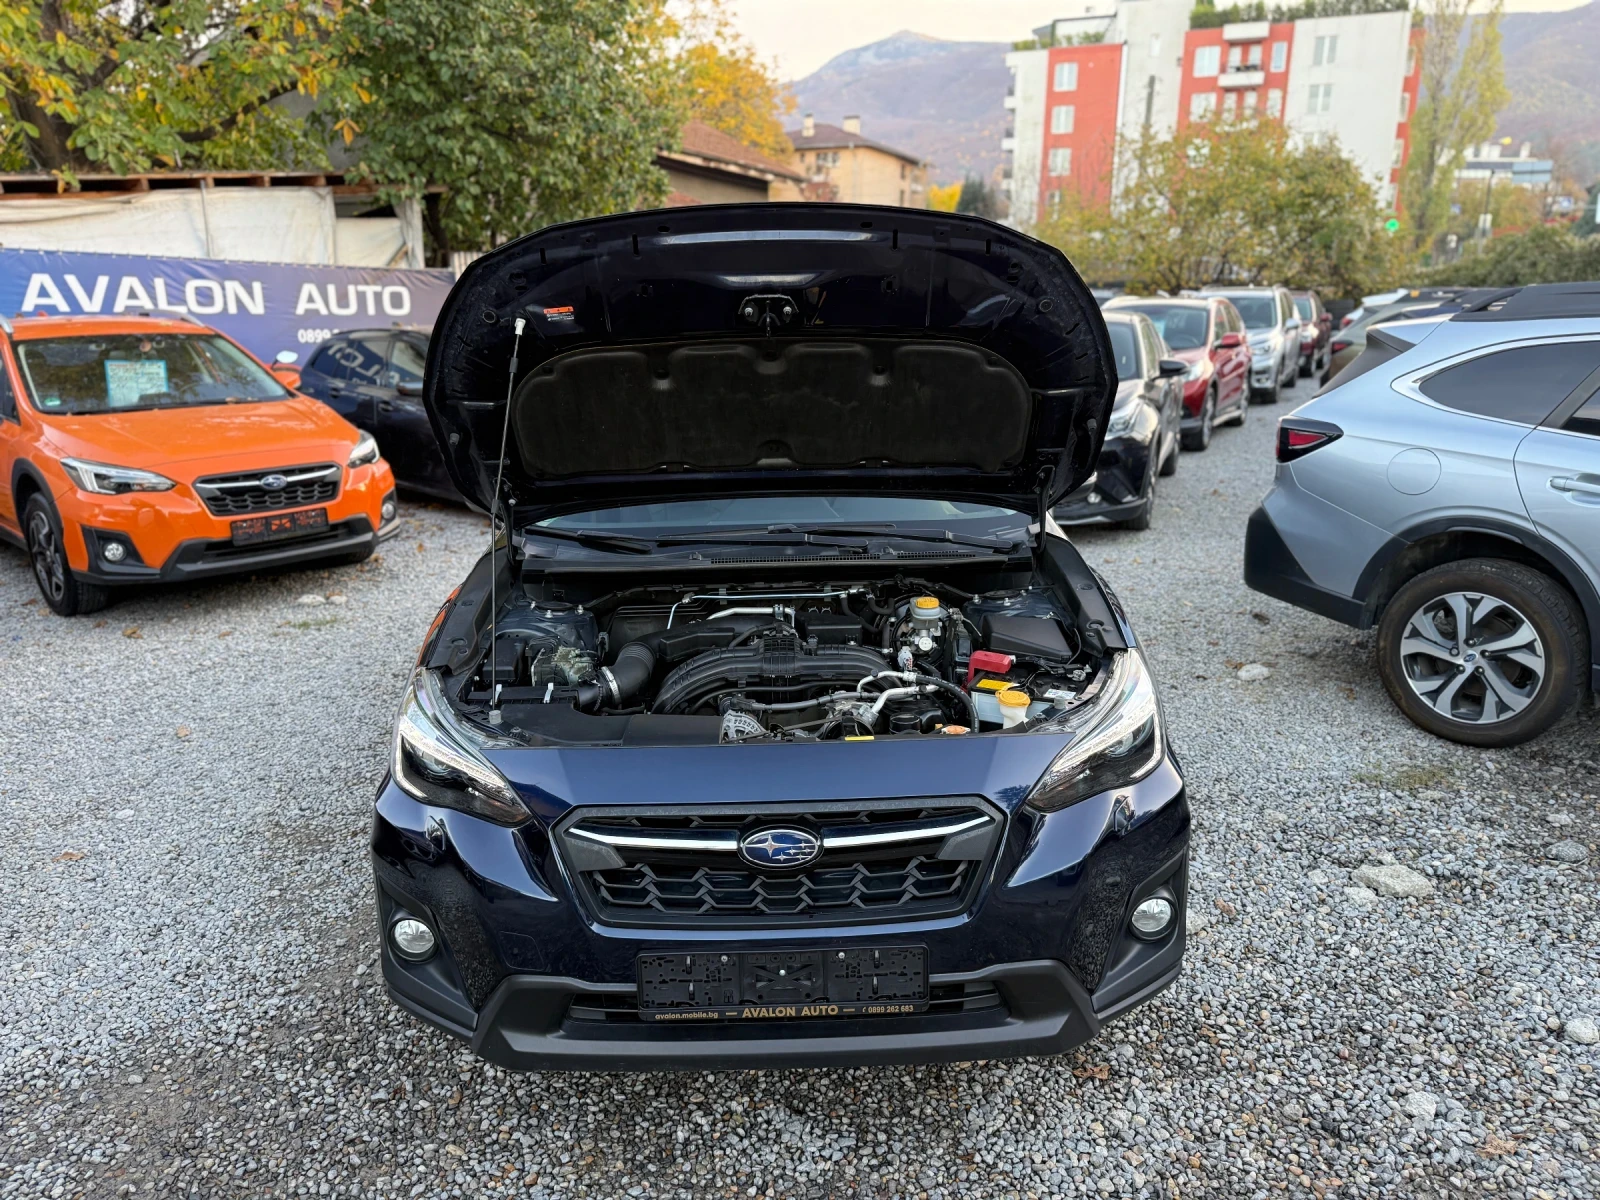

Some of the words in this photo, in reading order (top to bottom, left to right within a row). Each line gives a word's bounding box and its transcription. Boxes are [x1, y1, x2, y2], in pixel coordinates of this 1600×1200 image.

[21, 273, 265, 315] AVALON
[295, 283, 411, 316] AUTO
[655, 1011, 719, 1020] avalon.mobile.bg
[742, 1007, 796, 1018] AVALON
[801, 1005, 839, 1016] AUTO
[886, 1005, 899, 1013] 262
